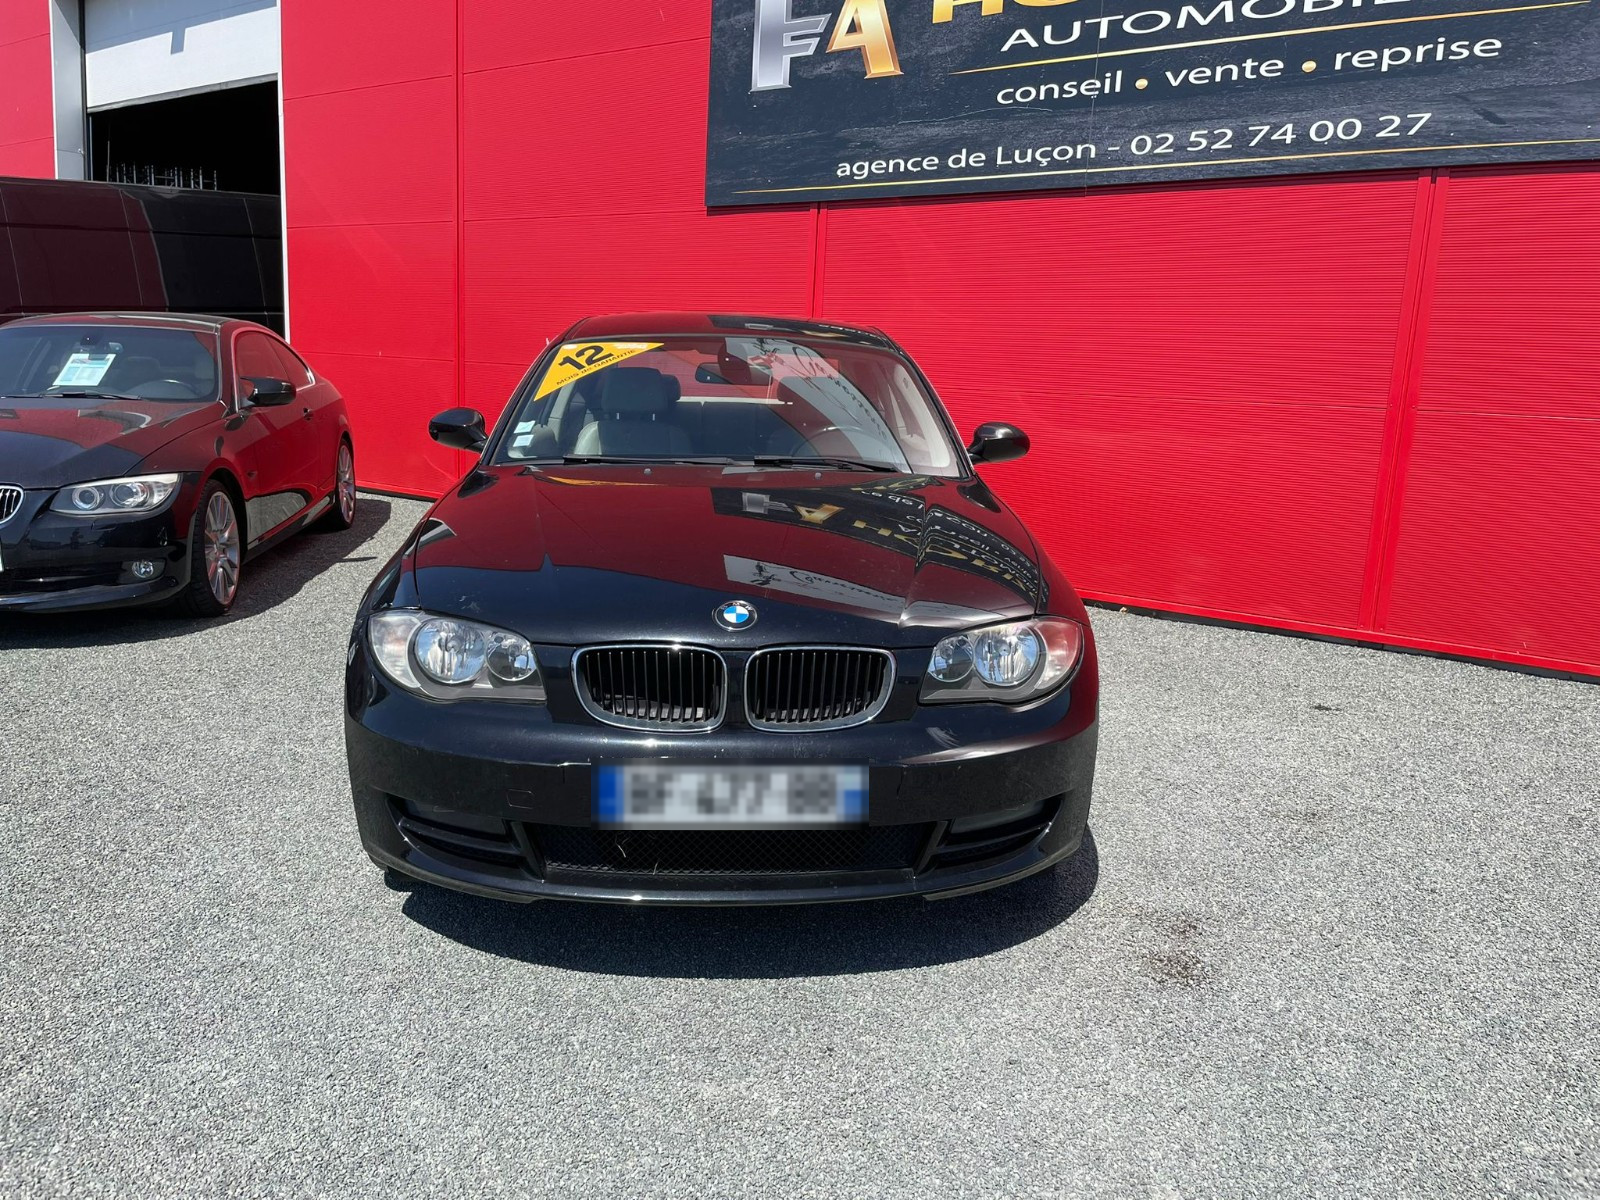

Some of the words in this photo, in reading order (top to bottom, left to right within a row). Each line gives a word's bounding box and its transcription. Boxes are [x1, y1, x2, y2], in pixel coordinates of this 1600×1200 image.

[997, 70, 1122, 105] conseil
[1164, 58, 1285, 87] vente
[1334, 37, 1502, 72] reprise
[836, 154, 939, 180] agence
[947, 148, 987, 169] de
[996, 141, 1097, 167] Luçon
[1130, 132, 1175, 156] 02
[1186, 128, 1233, 152] 52
[1248, 123, 1297, 147] 74
[1309, 118, 1363, 142] 00
[1375, 112, 1433, 138] 27
[558, 345, 615, 371] 12
